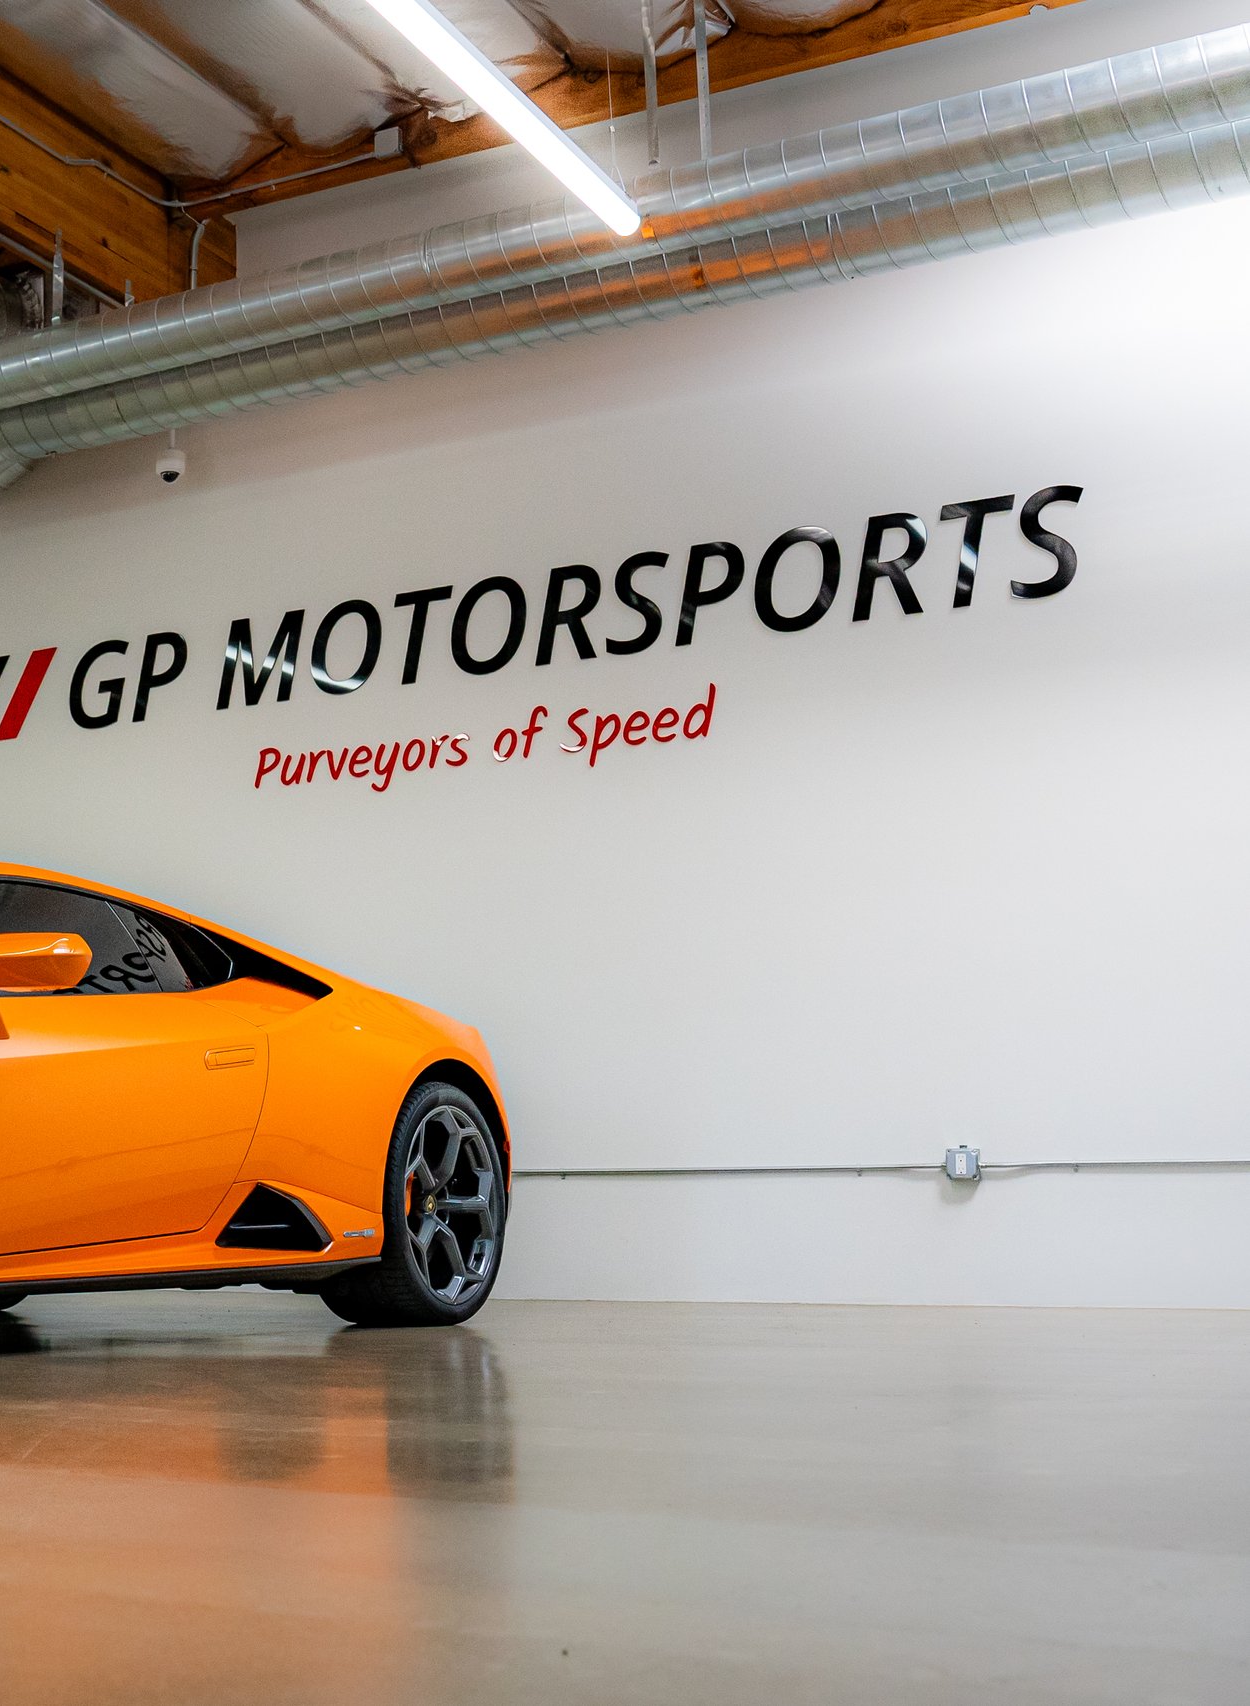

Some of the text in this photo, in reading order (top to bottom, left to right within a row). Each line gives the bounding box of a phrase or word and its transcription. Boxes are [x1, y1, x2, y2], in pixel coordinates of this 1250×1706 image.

[68, 485, 1084, 730] GP MOTORSPORTS
[254, 682, 717, 793] Purveyors of Speed
